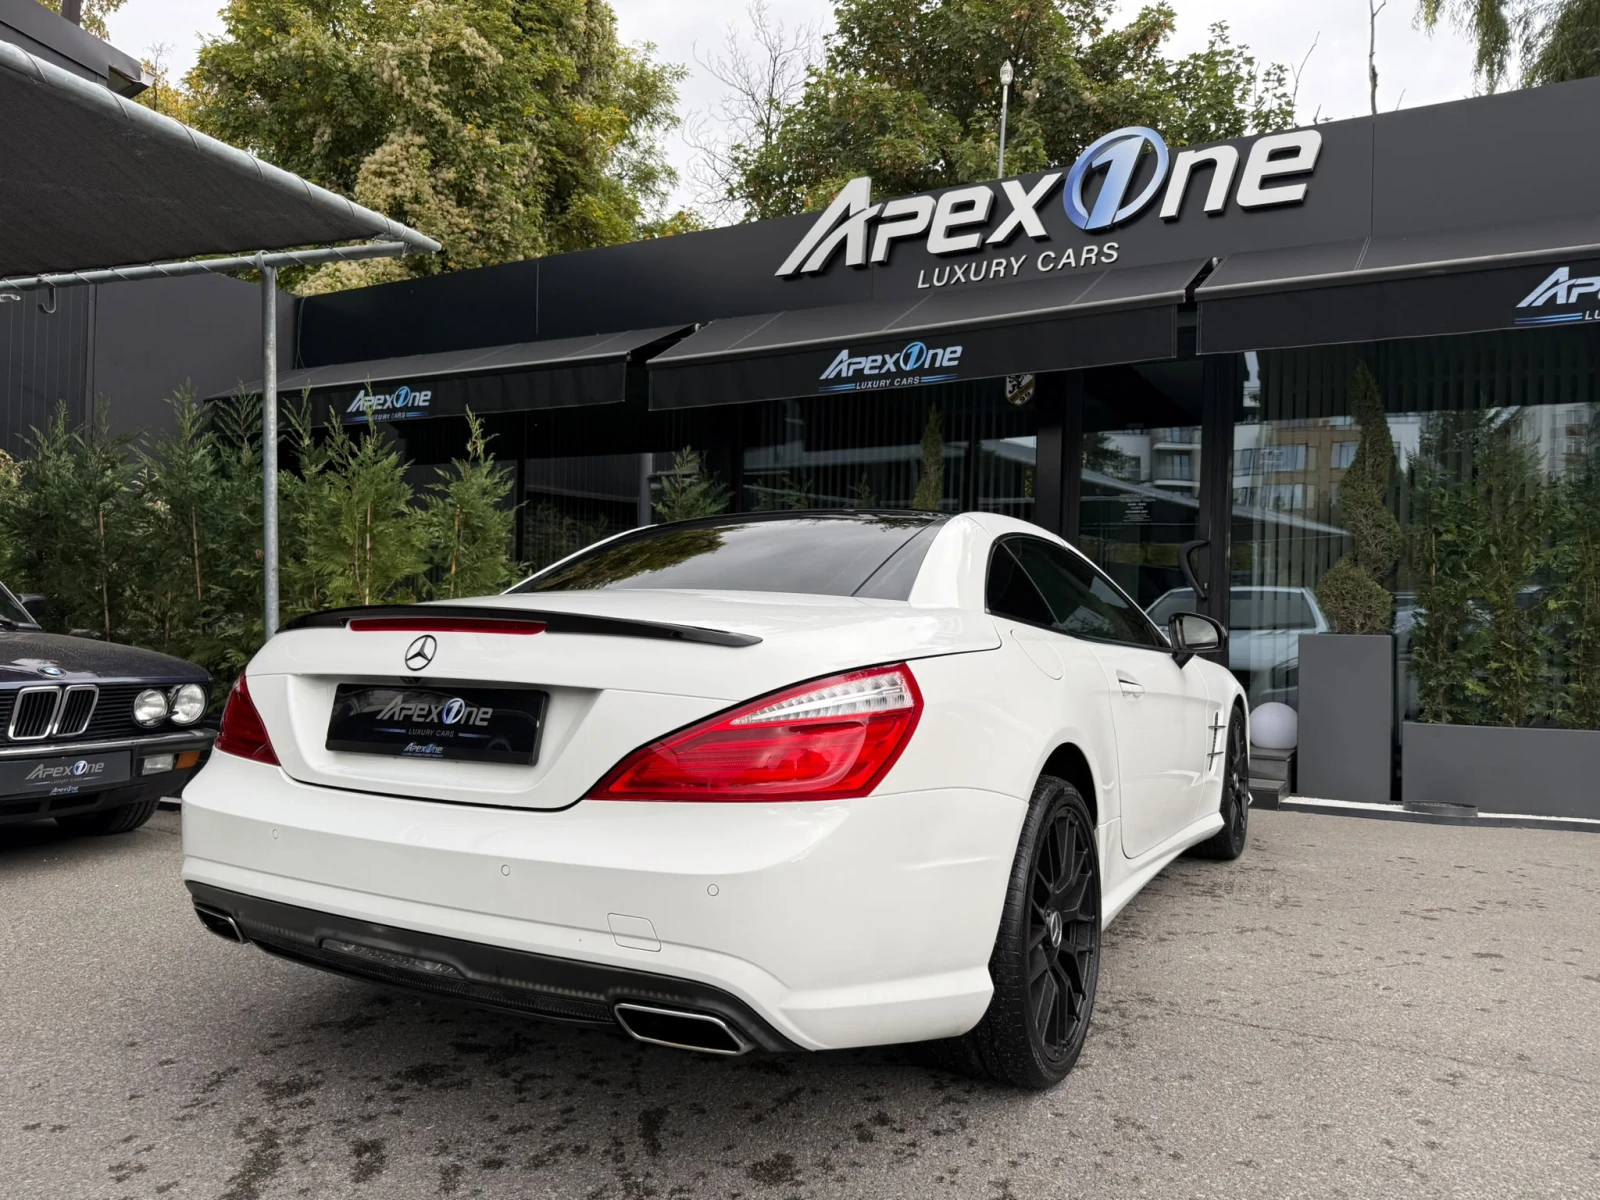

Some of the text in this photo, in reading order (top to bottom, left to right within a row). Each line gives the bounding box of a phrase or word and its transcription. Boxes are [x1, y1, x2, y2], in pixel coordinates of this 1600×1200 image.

[917, 242, 1120, 289] LUXURY CARS
[855, 376, 920, 390] LUXURY CARS
[408, 728, 455, 738] LUXURY CARS
